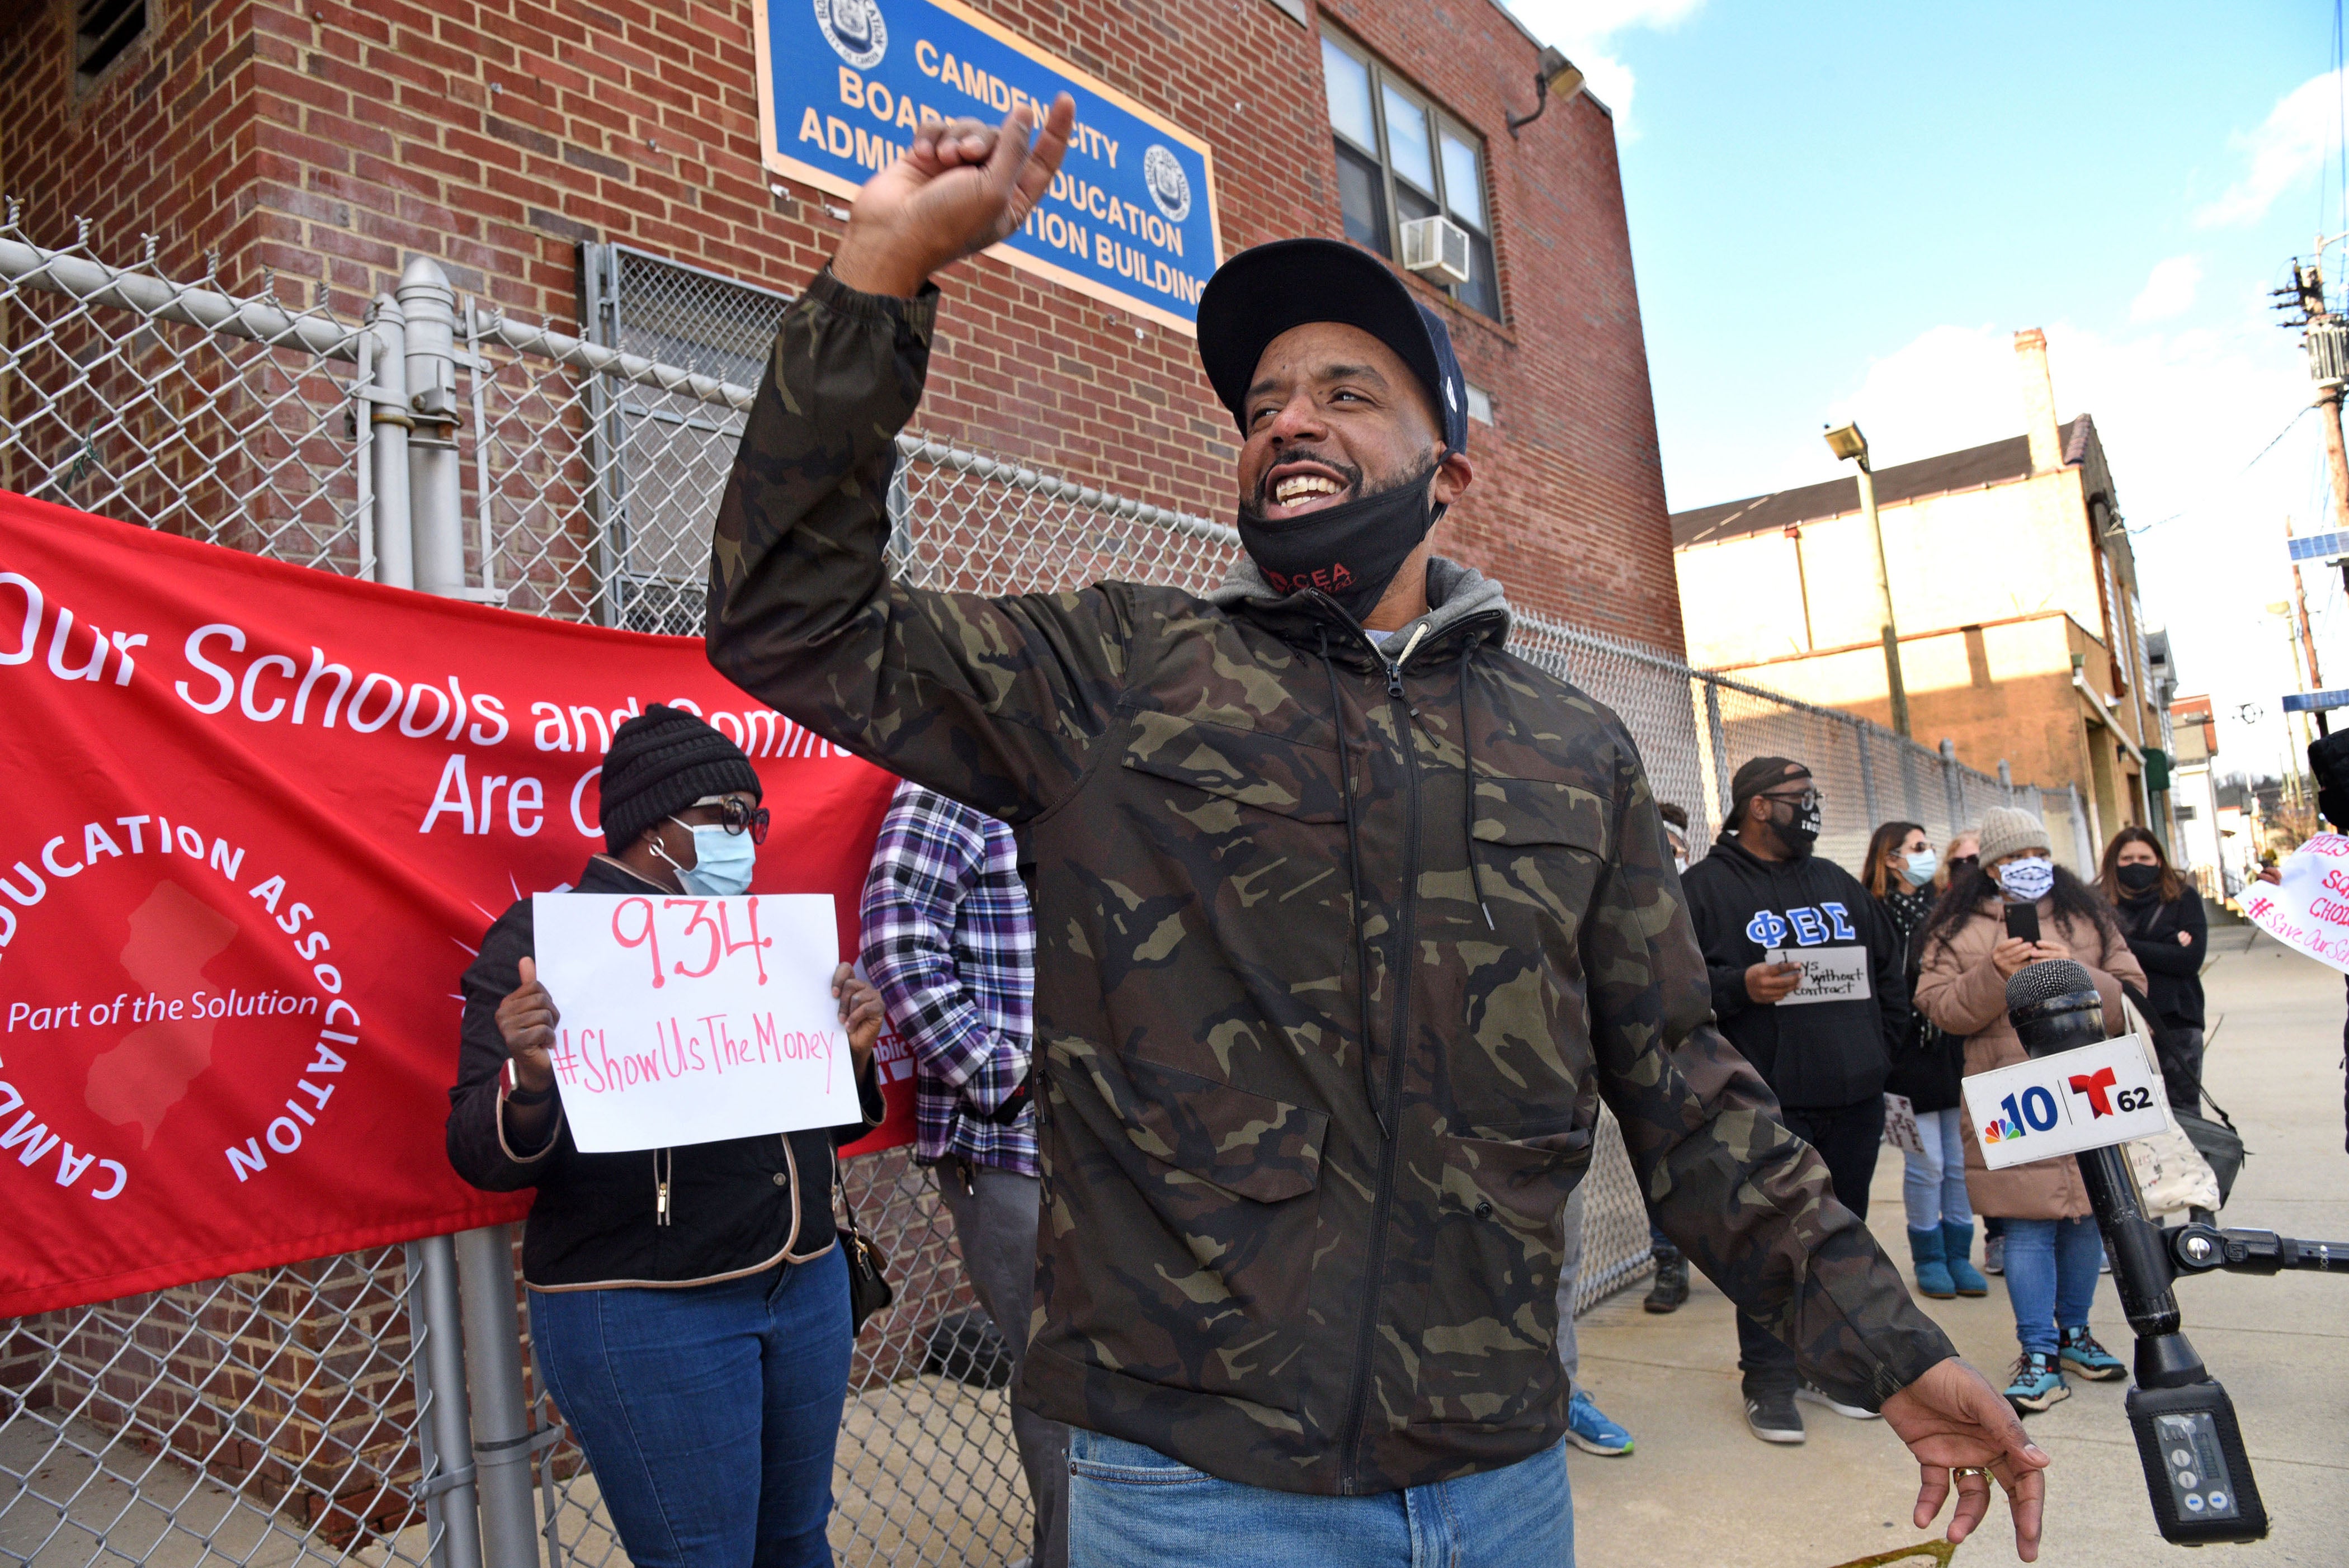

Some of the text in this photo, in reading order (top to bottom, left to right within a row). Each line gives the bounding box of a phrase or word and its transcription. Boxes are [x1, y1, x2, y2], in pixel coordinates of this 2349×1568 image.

[839, 65, 957, 135] BOA
[1044, 169, 1184, 257] DUCATION
[1292, 563, 1351, 588] CEA
[0, 572, 149, 687] Our
[174, 624, 510, 746] Schools
[418, 753, 544, 838] Are
[611, 896, 773, 989] 934
[1810, 968, 1864, 984] without
[0, 814, 361, 1201] CAMD UCATION ASSOCIATION
[7, 989, 318, 1032] Part of the Solution
[1794, 981, 1855, 996] contract
[552, 1011, 834, 1095] #ShowUsTheMoney
[2001, 1085, 2058, 1137] 10
[2116, 1087, 2154, 1113] 62
